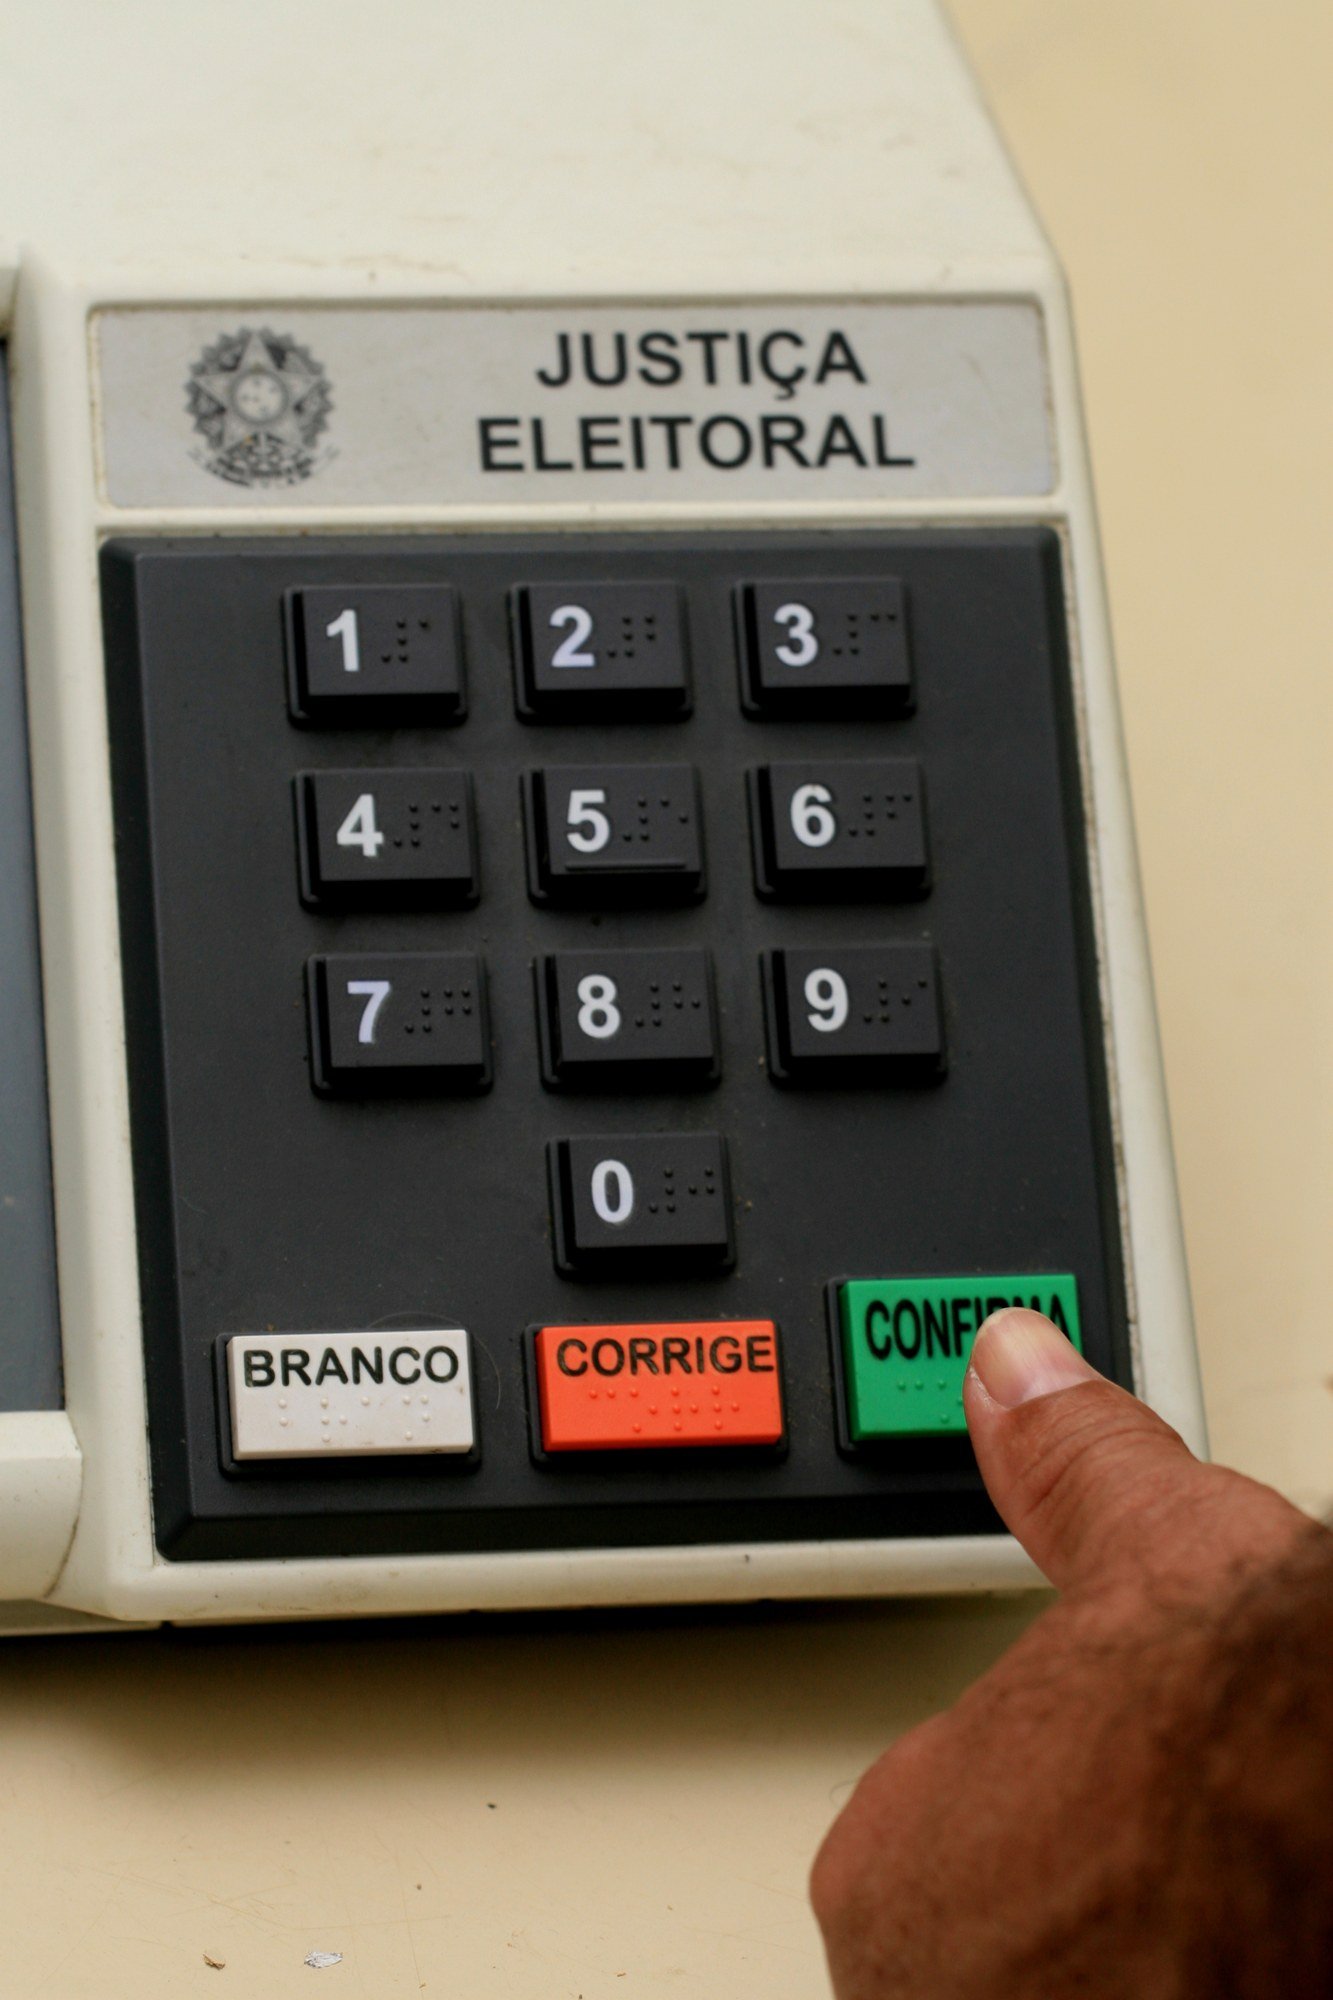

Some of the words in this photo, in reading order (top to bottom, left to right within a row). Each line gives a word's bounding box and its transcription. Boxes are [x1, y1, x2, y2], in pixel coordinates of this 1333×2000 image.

[536, 330, 867, 401] JUSTIÇA
[478, 414, 915, 473] ELEITORAL
[326, 608, 359, 672] 1
[549, 604, 596, 668] 2
[774, 603, 818, 667] 3
[336, 792, 385, 857] 4
[566, 789, 610, 853] 5
[790, 784, 835, 847] 6
[346, 980, 391, 1044] 7
[577, 974, 621, 1039] 8
[804, 968, 849, 1032] 9
[591, 1159, 634, 1224] 0
[557, 1335, 777, 1377] CORRIGE
[864, 1294, 1073, 1360] CONFIA
[243, 1345, 459, 1388] BRANCO
